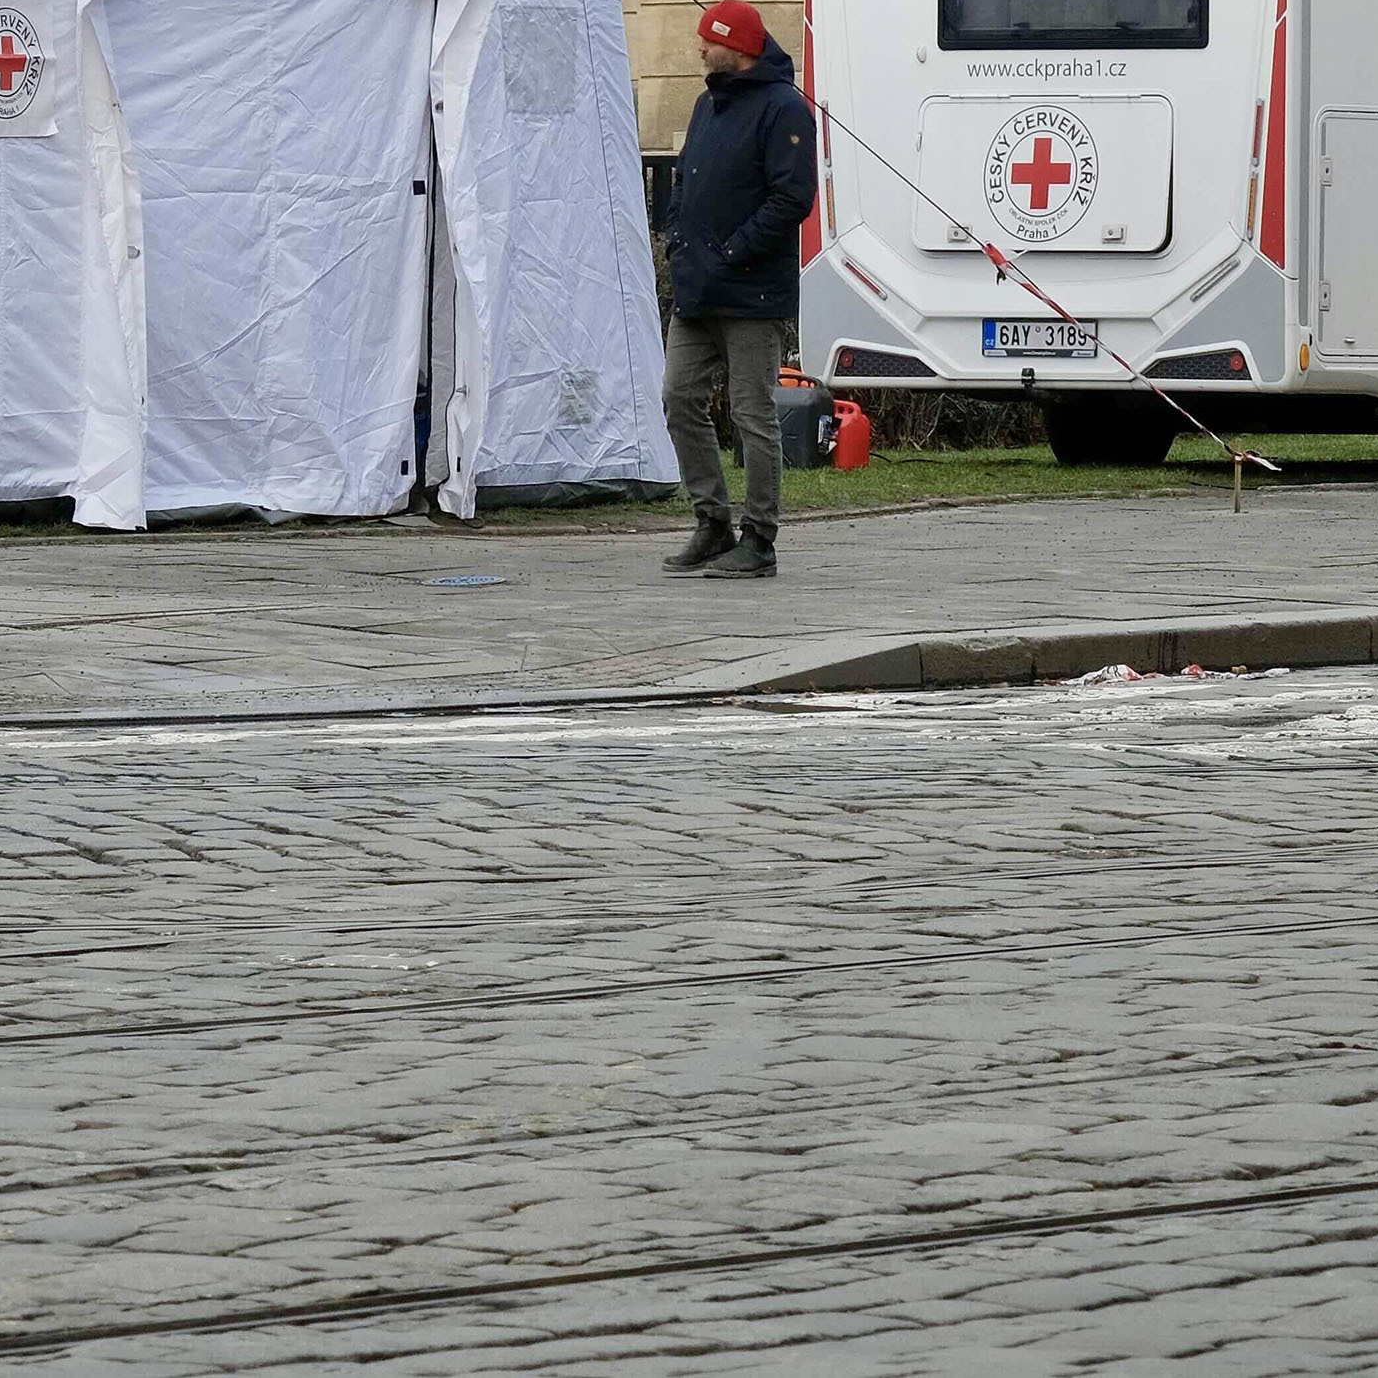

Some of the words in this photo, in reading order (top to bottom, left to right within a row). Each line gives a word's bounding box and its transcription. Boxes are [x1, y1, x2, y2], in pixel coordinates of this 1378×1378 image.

[967, 58, 1127, 81] www.cckpraha1.cz
[989, 134, 1011, 204] ČESKÝ
[1013, 111, 1089, 149] ČERVENÝ
[1073, 156, 1096, 206] KŘÍŽ
[1016, 224, 1049, 239] Praha
[1052, 224, 1058, 235] 1
[1000, 325, 1030, 346] 6AY
[1045, 325, 1087, 346] 3189
